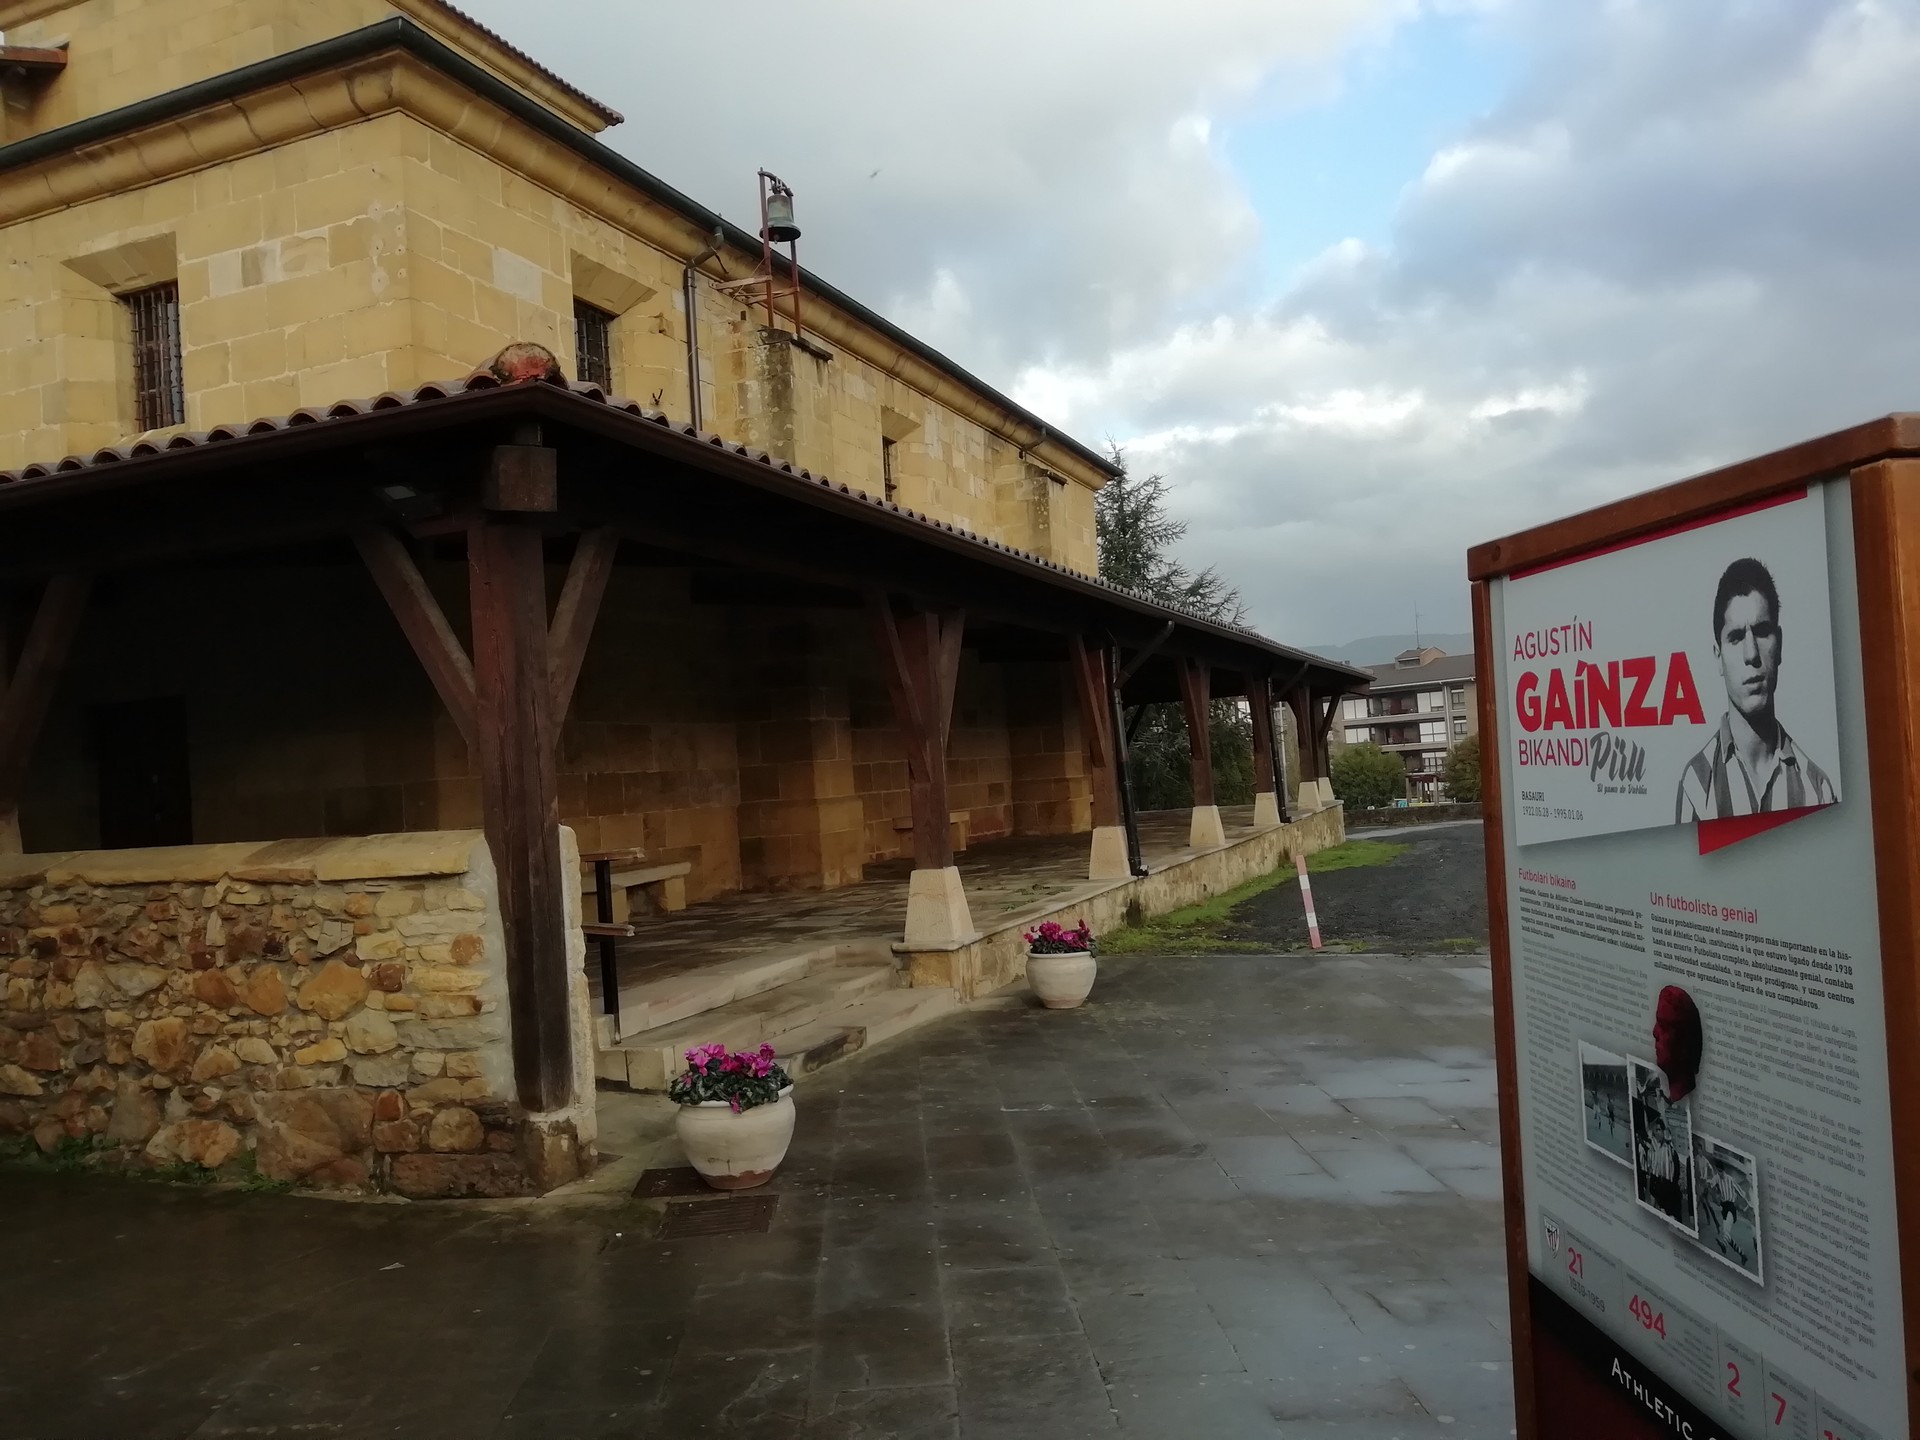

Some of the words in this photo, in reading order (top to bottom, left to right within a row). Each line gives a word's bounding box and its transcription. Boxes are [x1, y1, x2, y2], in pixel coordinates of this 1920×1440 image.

[1513, 615, 1592, 662] AGUSTÍN
[1516, 651, 1707, 732] GAÍNZA
[1518, 738, 1589, 767] BIKANDI
[1590, 731, 1646, 782] Piru
[1521, 791, 1545, 801] BASAURI
[1518, 868, 1548, 884] Futbolari
[1550, 873, 1575, 889] bikaina
[1650, 891, 1663, 906] Un
[1666, 893, 1717, 916] futbolista
[1721, 902, 1758, 927] genial
[1673, 929, 1692, 940] Athletic
[1745, 945, 1751, 953] la
[1752, 948, 1764, 957] que
[1765, 950, 1786, 961] estuvo
[1788, 954, 1809, 968] ligado
[1811, 958, 1832, 971] desde
[1834, 962, 1852, 975] 1938
[1675, 918, 1713, 934] probablemente
[1721, 927, 1743, 938] nombre
[1744, 933, 1764, 944] propio
[1780, 939, 1817, 955] importante
[1828, 948, 1835, 957] la
[1686, 969, 1695, 978] que
[1755, 986, 1763, 995] de
[1694, 945, 1720, 959] Futbolista
[1751, 959, 1798, 977] absolutamente
[1799, 969, 1823, 985] genial,
[1824, 975, 1853, 990] contaba
[1743, 971, 1762, 983] regate
[1802, 986, 1806, 994] y
[1808, 987, 1825, 997] unos
[1827, 991, 1854, 1004] centros
[1568, 1247, 1583, 1279] 21
[1629, 1294, 1666, 1340] 494
[1727, 1362, 1741, 1397] 2
[1611, 1357, 1692, 1440] ATHLETIC
[1771, 1392, 1786, 1425] 7
